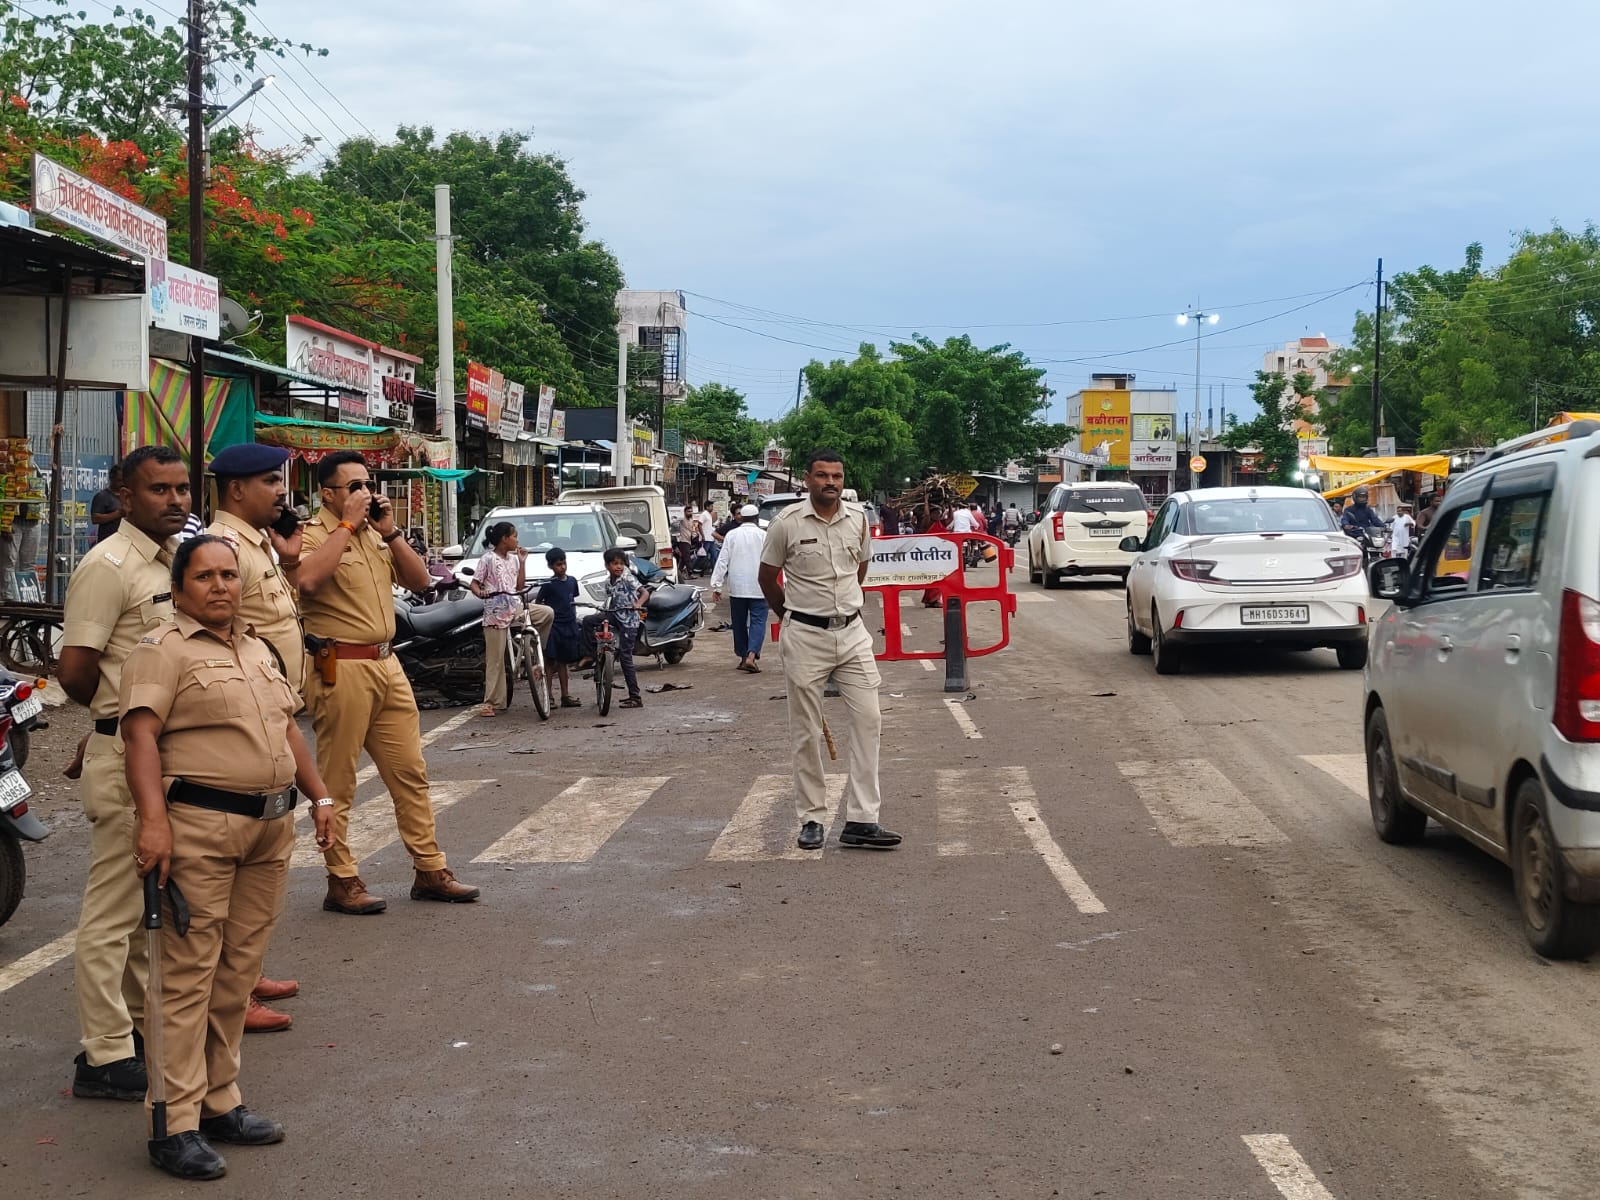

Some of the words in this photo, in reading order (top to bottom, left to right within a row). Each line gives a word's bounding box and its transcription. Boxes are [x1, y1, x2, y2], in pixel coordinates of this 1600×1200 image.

[1085, 413, 1129, 425] बळीराजा
[1134, 453, 1172, 463] आदिनाथ
[910, 546, 952, 561] पोलीस
[1249, 609, 1306, 619] MH16DS3641
